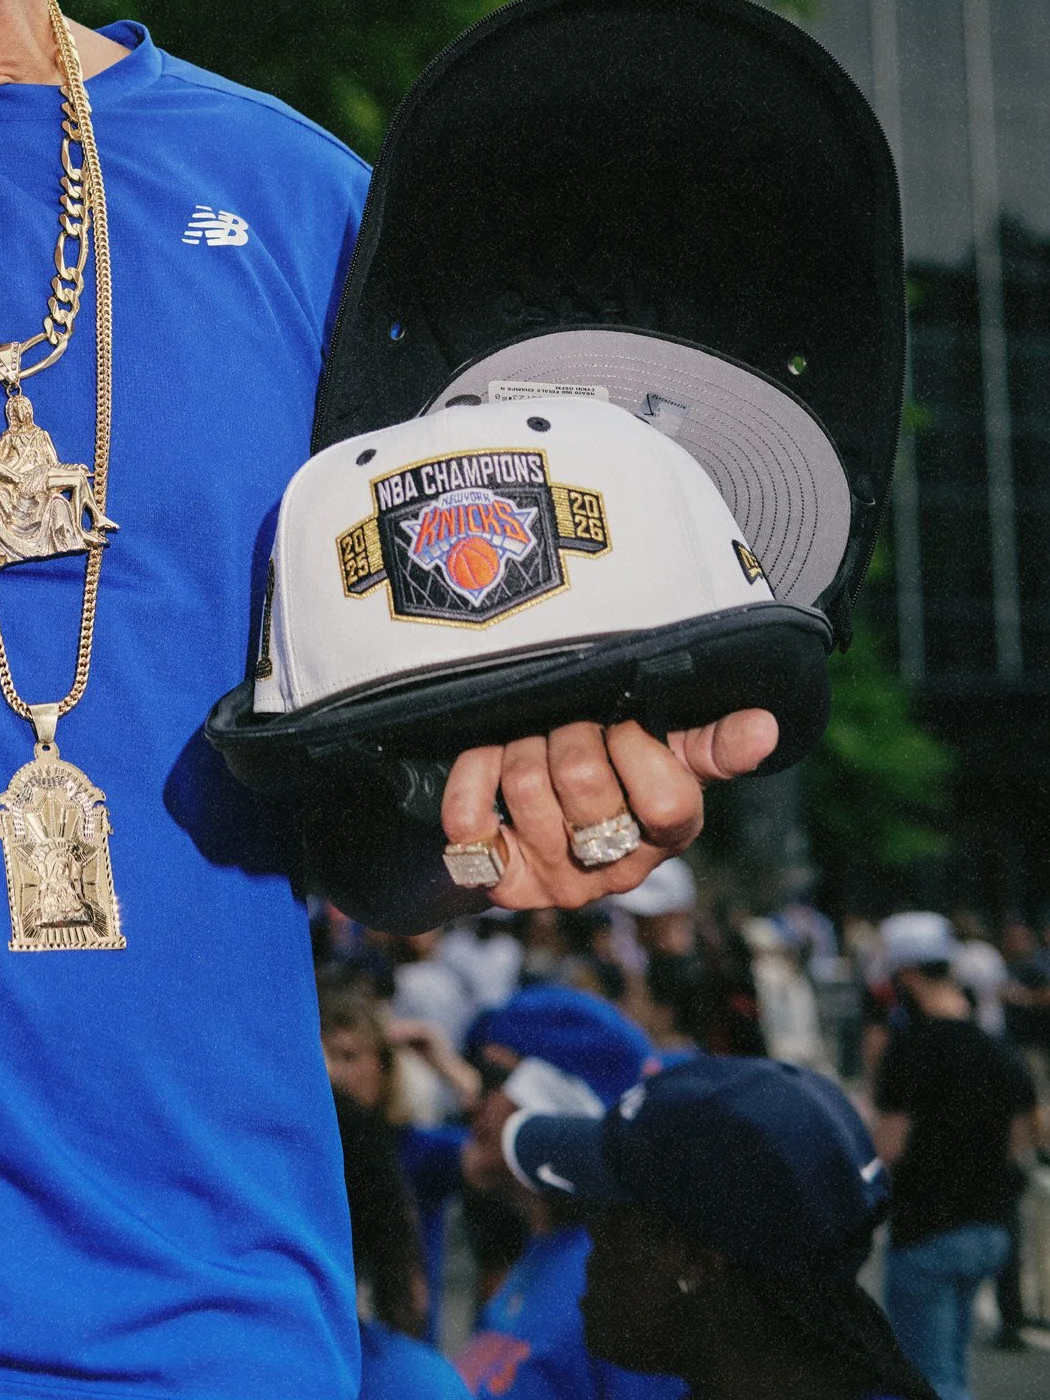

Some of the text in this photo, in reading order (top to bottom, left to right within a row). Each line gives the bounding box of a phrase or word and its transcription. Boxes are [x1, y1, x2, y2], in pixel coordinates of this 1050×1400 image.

[377, 454, 545, 511] NBA CHAMPIONS
[441, 491, 491, 507] NEW YORK
[570, 491, 600, 518] 20
[341, 527, 365, 562] 20
[414, 500, 530, 554] KNICKS
[575, 515, 605, 542] 26
[346, 551, 369, 586] 25
